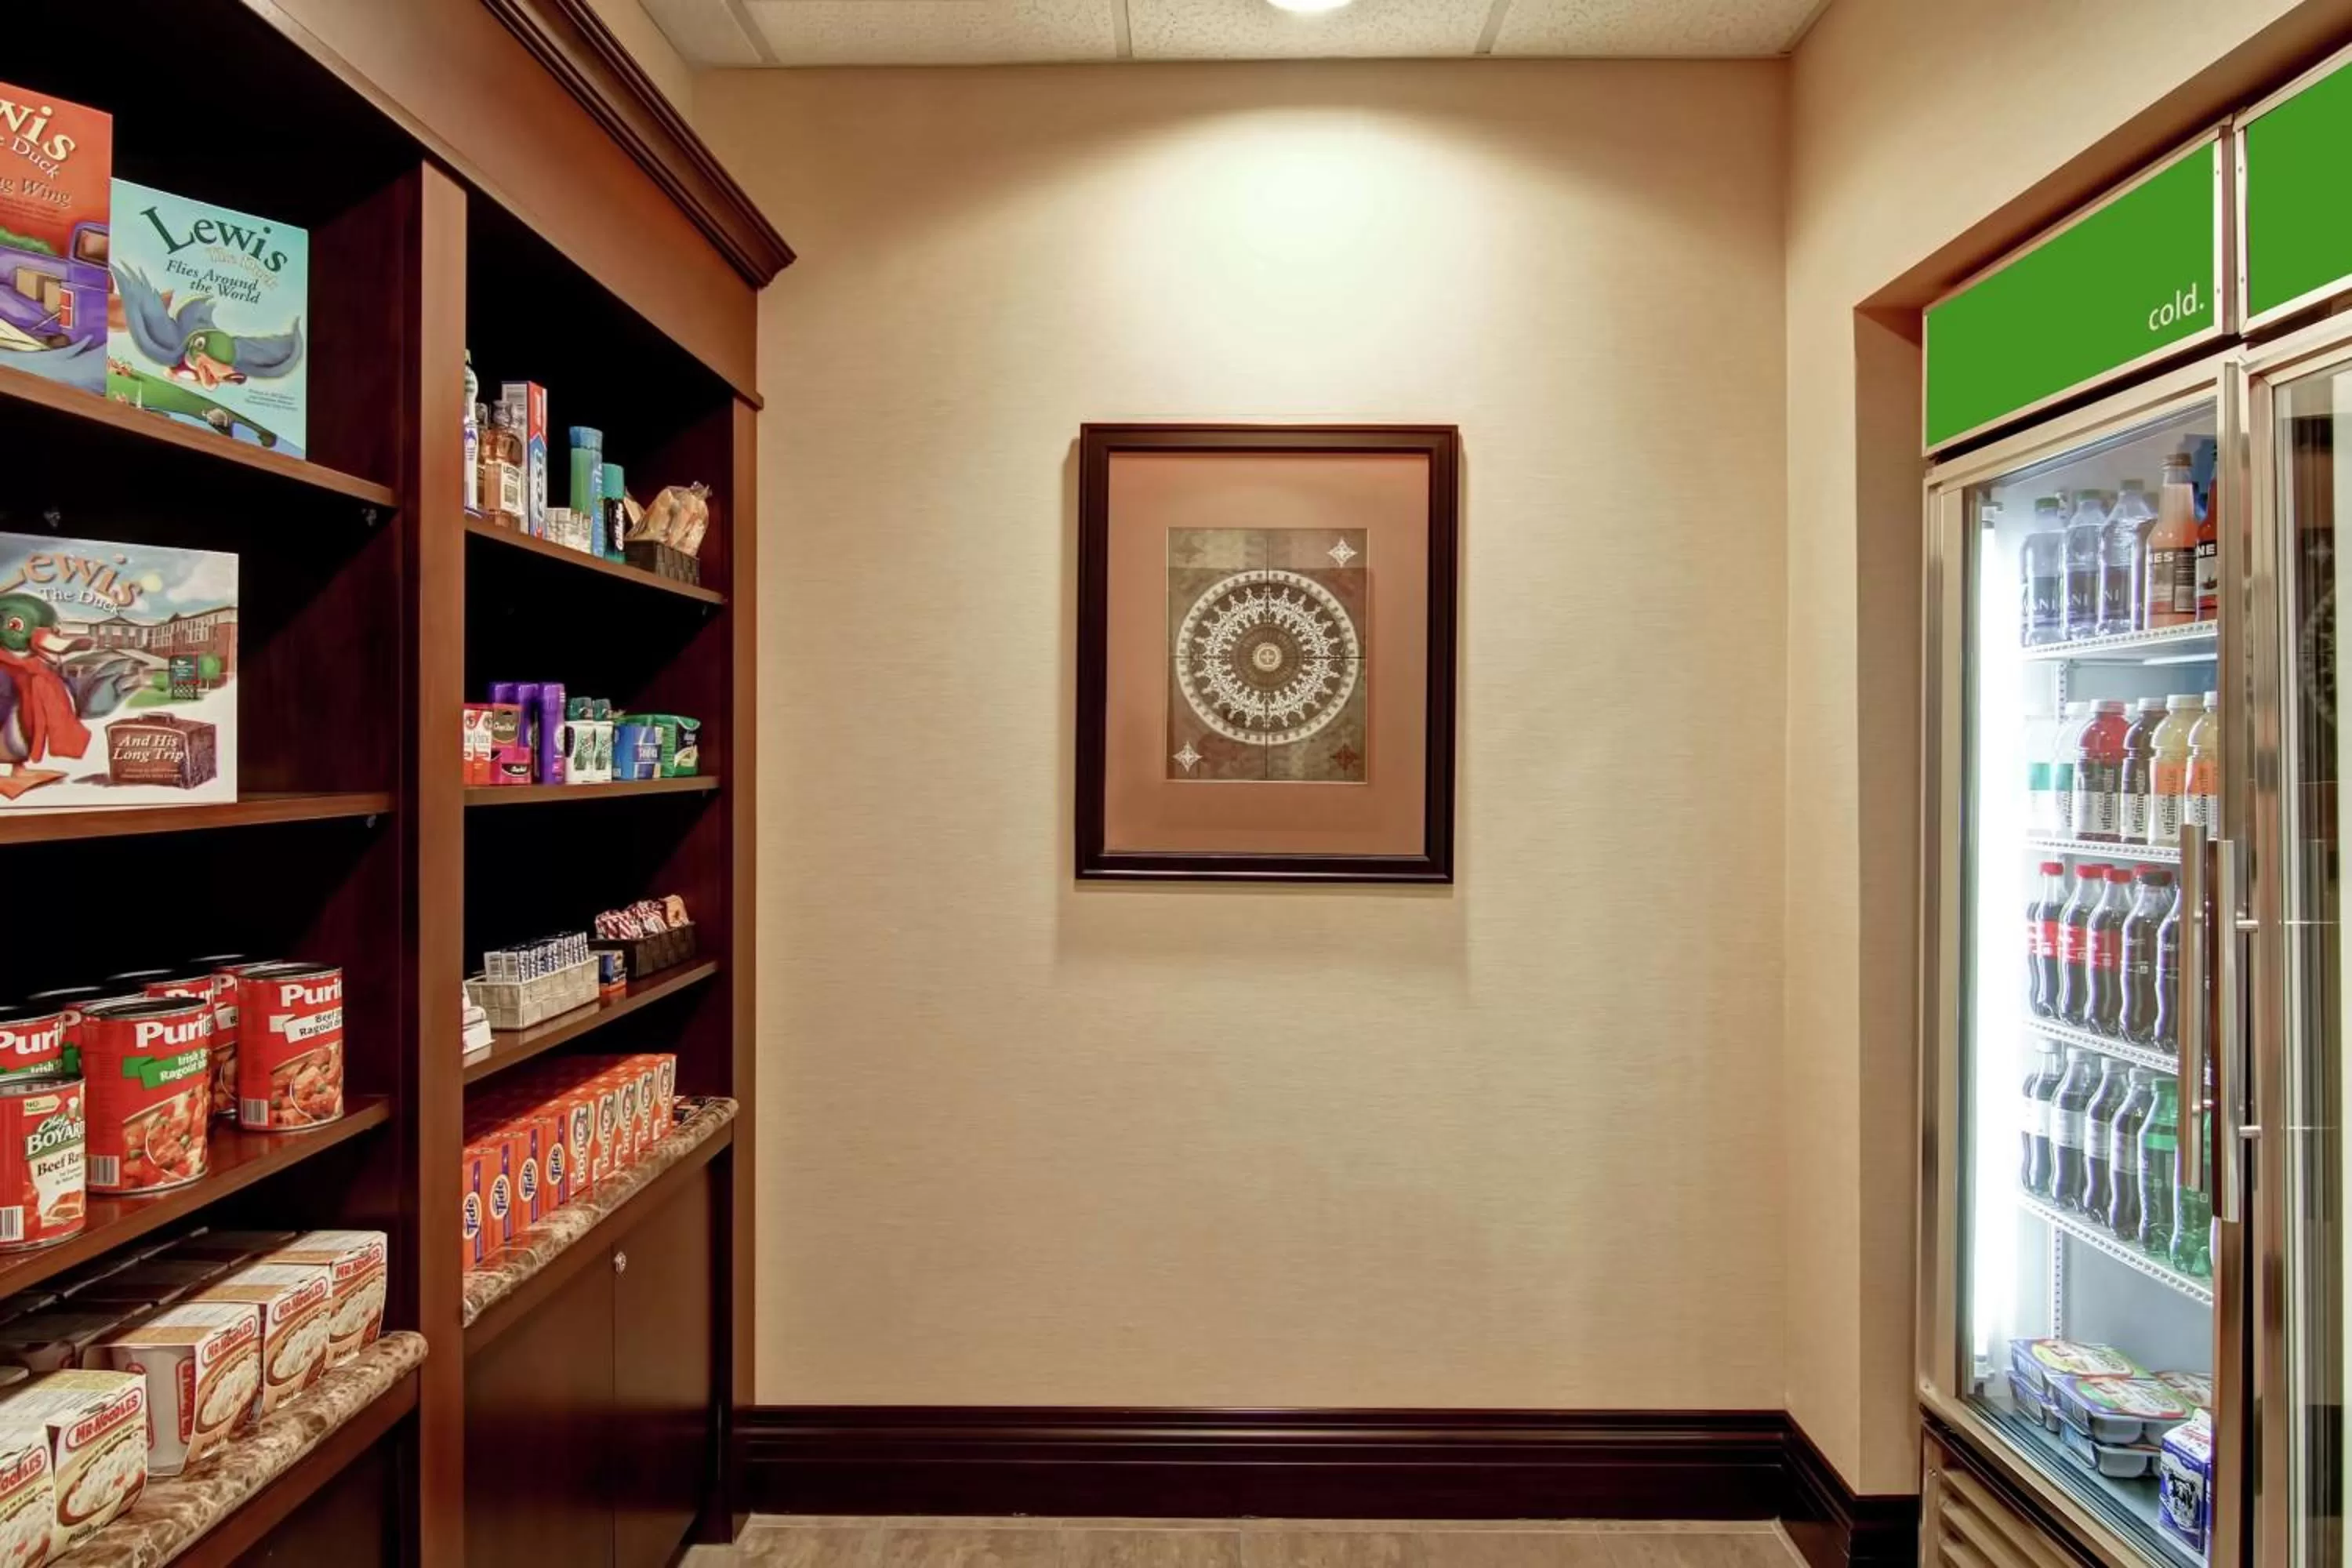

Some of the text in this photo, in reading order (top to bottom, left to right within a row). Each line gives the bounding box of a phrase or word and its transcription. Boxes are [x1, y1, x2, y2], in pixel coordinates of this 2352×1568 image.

[12, 137, 60, 180] Duck
[22, 177, 71, 208] Wing
[140, 206, 289, 272] Lewis
[165, 260, 259, 291] Flies Around
[190, 279, 262, 304] the World
[2148, 281, 2205, 331] cold.
[40, 588, 124, 615] The Duck
[113, 747, 184, 764] Long Trip
[118, 734, 179, 747] And His
[37, 1155, 66, 1177] Beef
[523, 1163, 535, 1197] Tide
[495, 1179, 506, 1215] Tide
[466, 1199, 477, 1236] Tide
